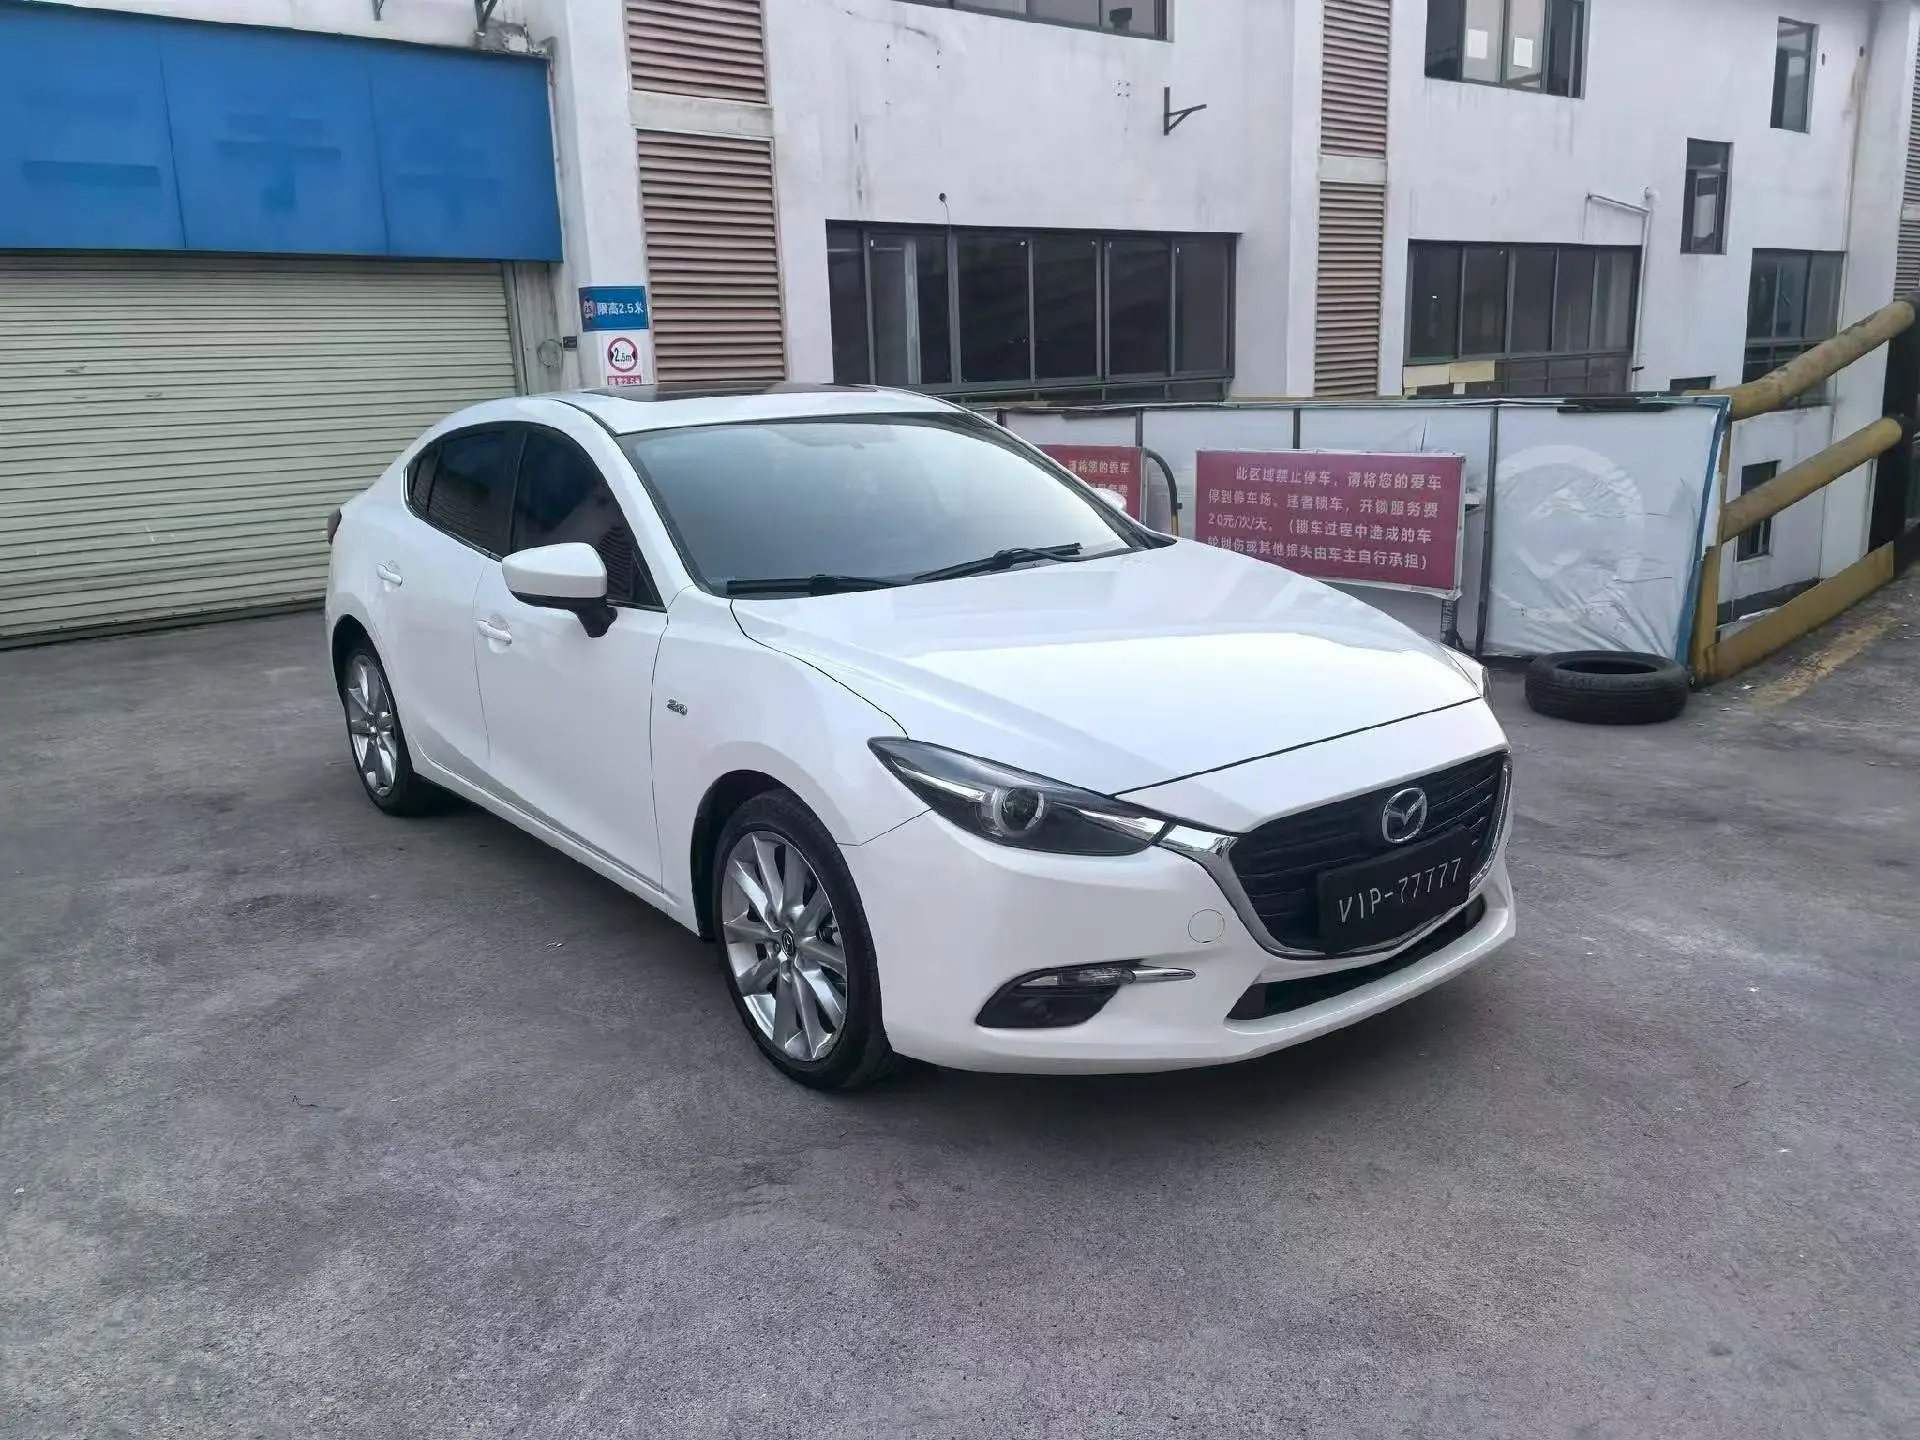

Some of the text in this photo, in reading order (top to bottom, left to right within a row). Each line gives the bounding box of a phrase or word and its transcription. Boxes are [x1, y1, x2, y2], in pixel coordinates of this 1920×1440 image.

[596, 302, 645, 315] 限高2.5米
[614, 347, 632, 362] 2.5m
[1339, 857, 1462, 923] VIP-77777
